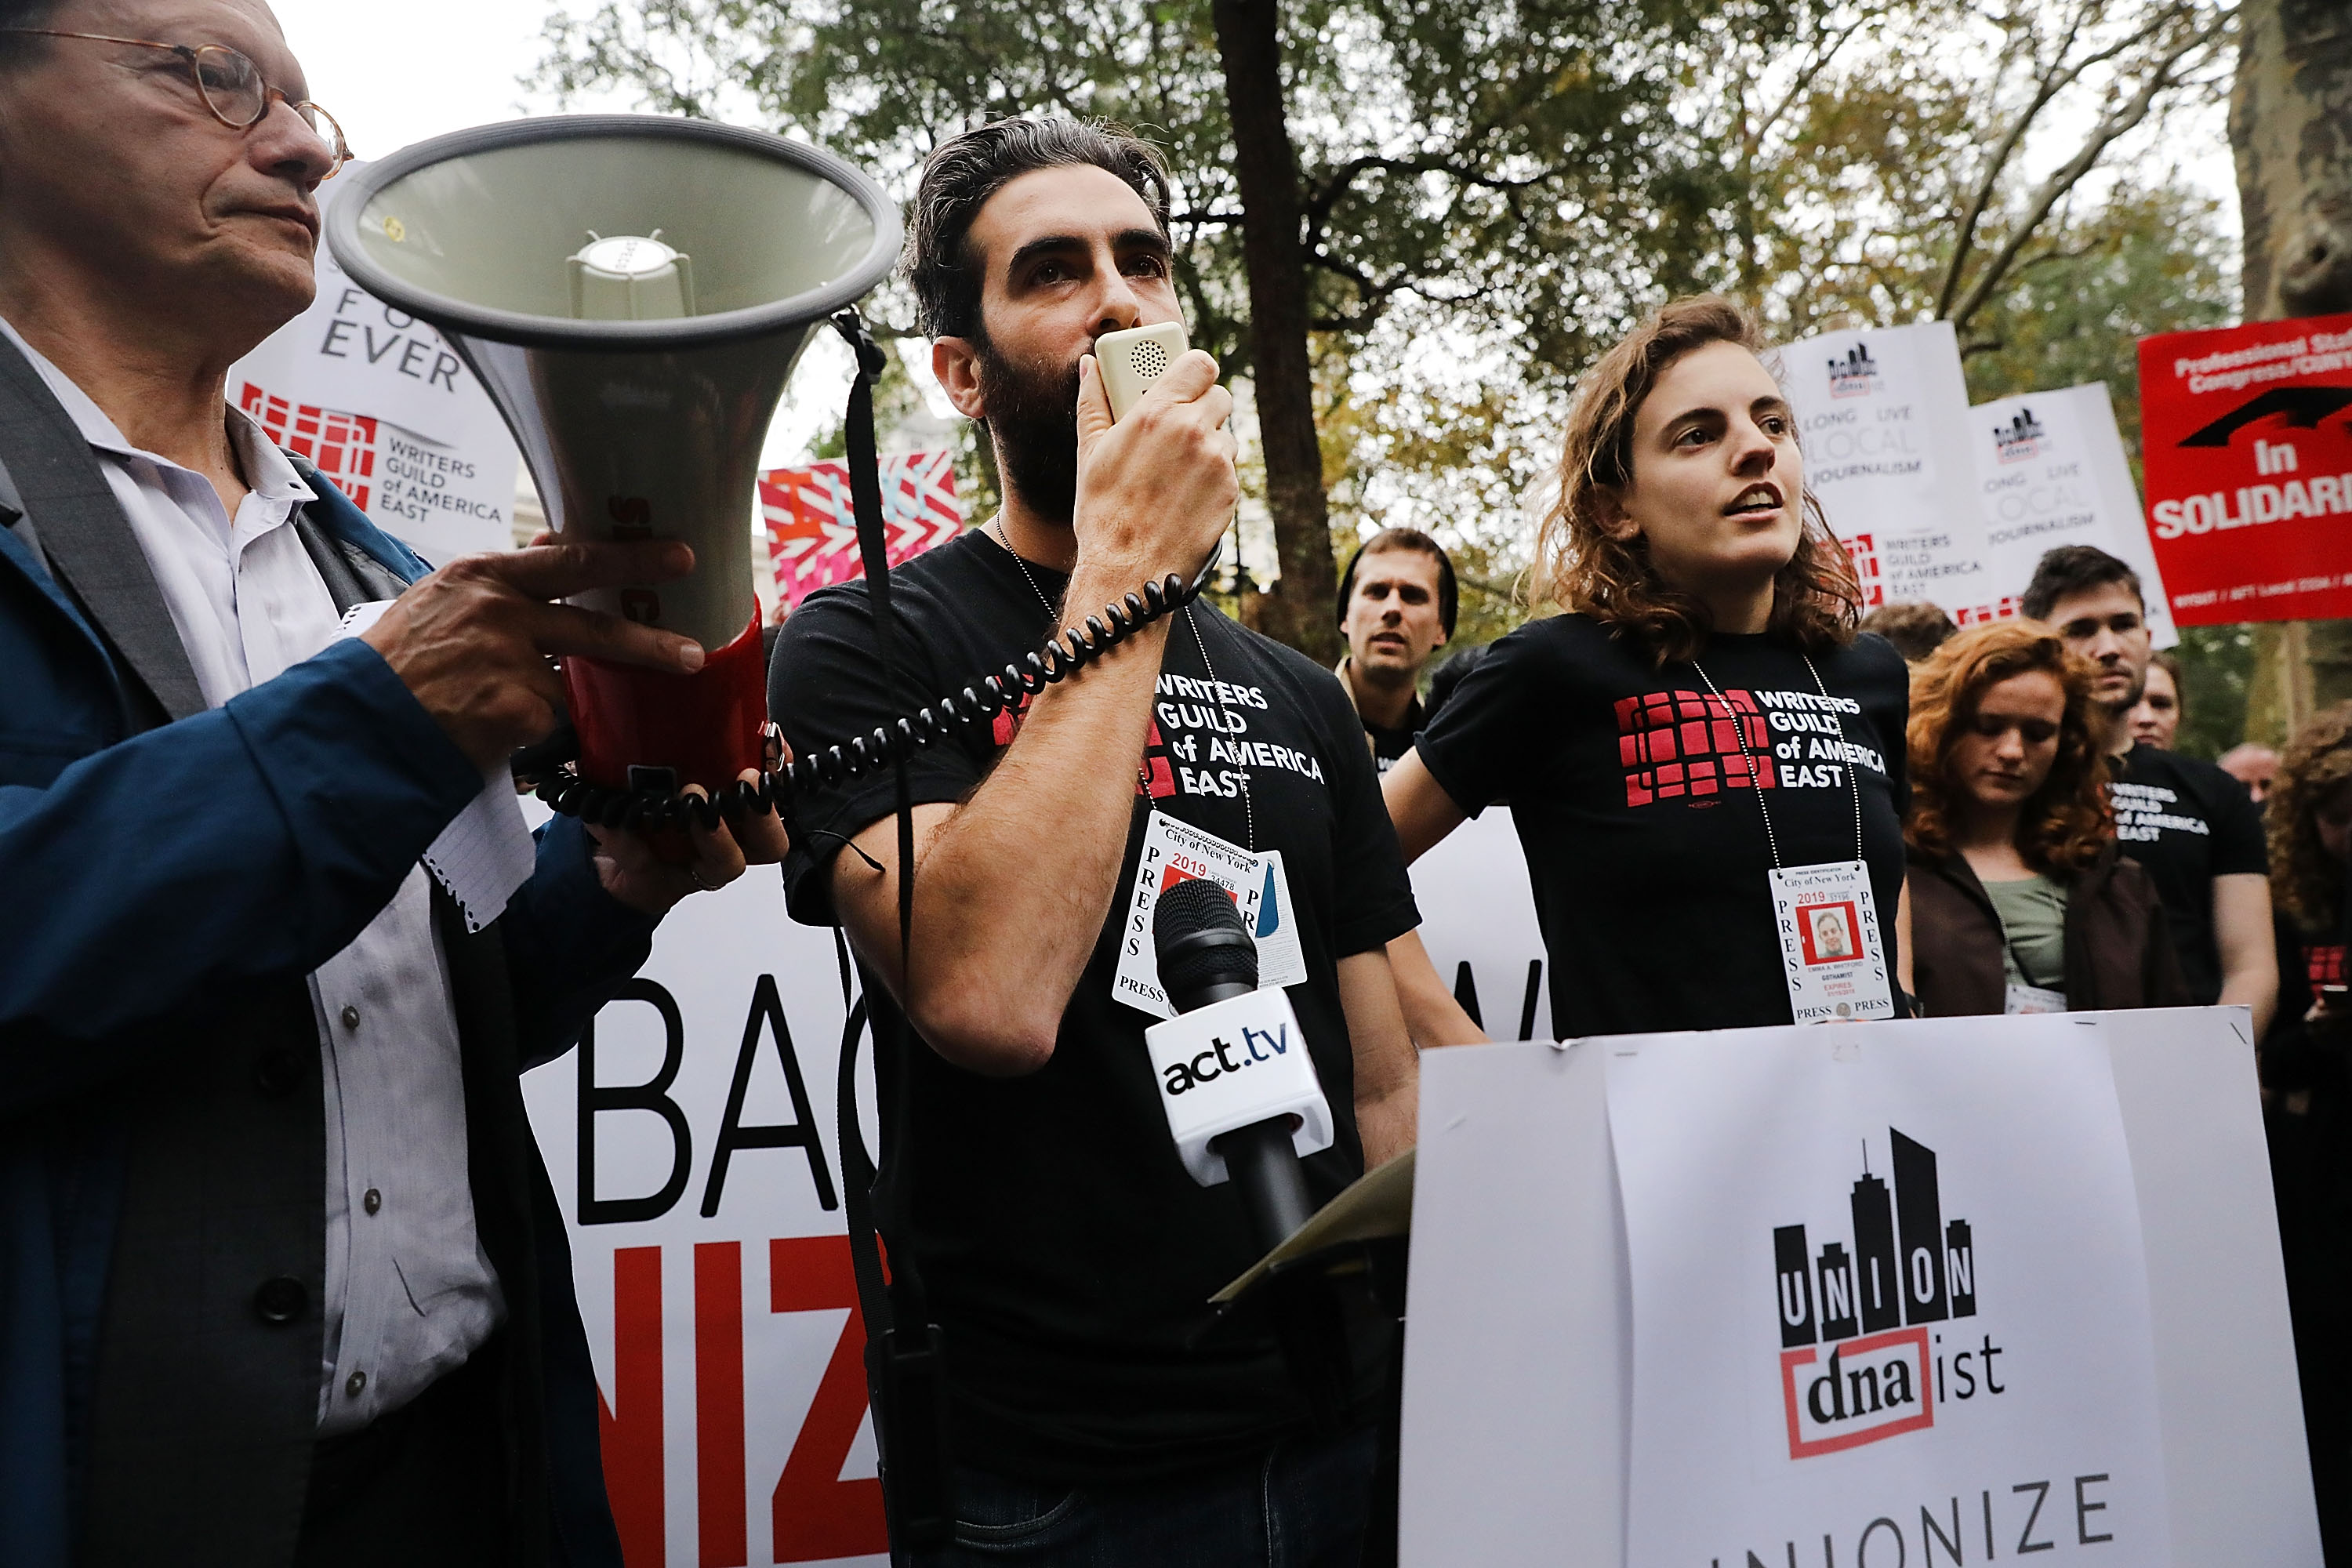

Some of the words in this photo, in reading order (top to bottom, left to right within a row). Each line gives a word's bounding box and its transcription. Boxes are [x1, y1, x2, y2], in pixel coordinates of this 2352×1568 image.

[321, 319, 459, 393] EVER
[1804, 408, 1857, 432] LONG
[1876, 404, 1913, 422] LIVE
[390, 437, 475, 478] WRITERS
[1806, 427, 1918, 463] LOCAL
[2253, 439, 2298, 475] In
[387, 457, 445, 488] GUILD
[1812, 459, 1922, 488] JOURNALISM
[381, 493, 429, 523] EAST
[383, 479, 401, 493] of
[407, 486, 502, 524] AMERICA
[1985, 485, 2091, 524] OCAL
[1884, 532, 1951, 550] WRITERS
[1888, 553, 1931, 566] GUILD
[1908, 560, 1984, 579] AMERICA
[1155, 674, 1268, 710] WRITERS
[1755, 690, 1860, 714] WRITERS
[1158, 702, 1247, 734] GUILD
[1769, 711, 1839, 735] GUILD
[1173, 735, 1197, 762] of
[1210, 737, 1325, 785] AMERICA
[1776, 735, 1802, 759] of
[1809, 738, 1886, 776] AMERICA
[1179, 767, 1251, 797] EAST
[1780, 764, 1843, 787] EAST
[2111, 795, 2163, 813] GUILD
[2117, 824, 2161, 842] EAST
[2134, 812, 2210, 836] AMERICA
[1165, 829, 1187, 847] City
[1189, 840, 1201, 851] of
[1201, 844, 1223, 861] New
[1226, 855, 1251, 873] York
[1172, 852, 1207, 877] 2019
[1211, 874, 1235, 891] 34478
[1784, 878, 1802, 888] City
[1805, 877, 1813, 885] of
[1815, 875, 1832, 884] New
[1835, 872, 1857, 882] York
[1127, 846, 1160, 956] PRESS
[1797, 891, 1826, 905] 2019
[1779, 900, 1802, 991] PRESS
[1860, 891, 1883, 981] PRESS
[1119, 975, 1164, 1003] PRESS
[1797, 1006, 1832, 1019] PRESS
[1855, 998, 1889, 1011] PRESS
[1163, 1022, 1287, 1095] act.tv
[1780, 1247, 1973, 1327] UNION
[1808, 1344, 1915, 1425] dna
[1711, 1473, 2114, 1568] ONIZE
